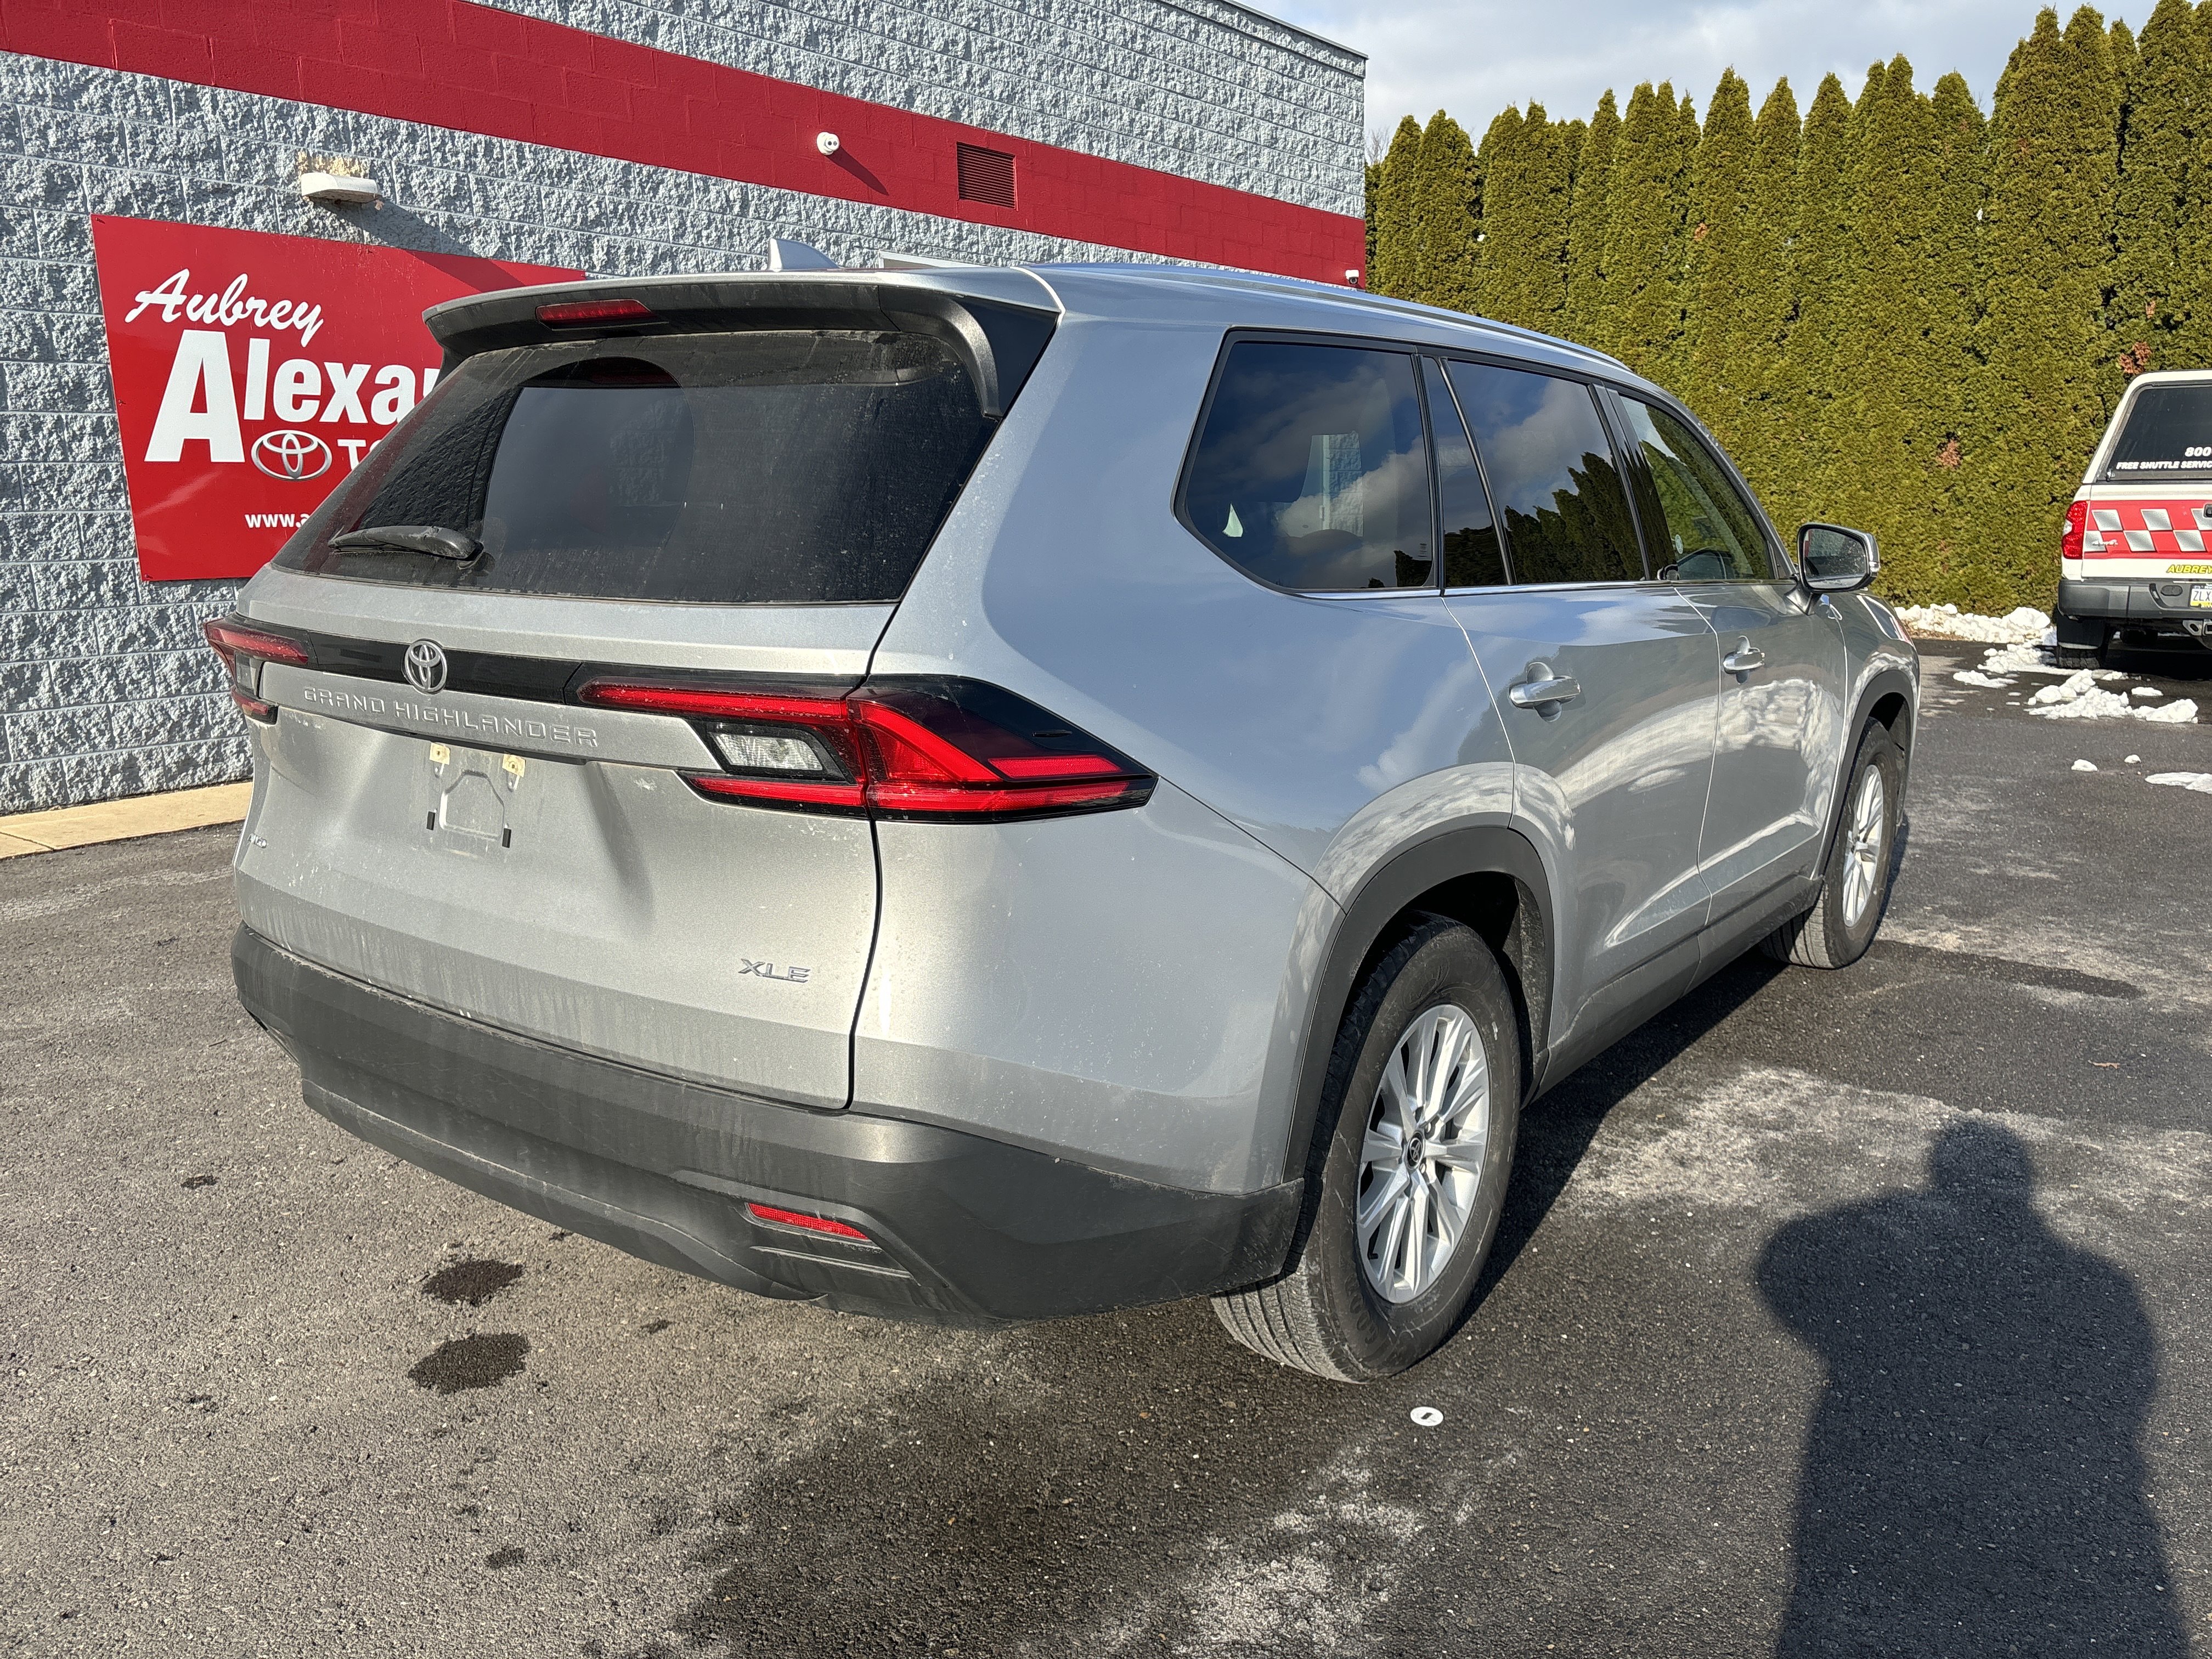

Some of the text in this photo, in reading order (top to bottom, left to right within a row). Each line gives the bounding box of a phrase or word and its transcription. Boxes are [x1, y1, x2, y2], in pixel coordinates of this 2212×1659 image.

[125, 268, 324, 348] Aubrey
[303, 687, 598, 747] GRAND HIGHLANDER
[738, 958, 810, 983] XLE
